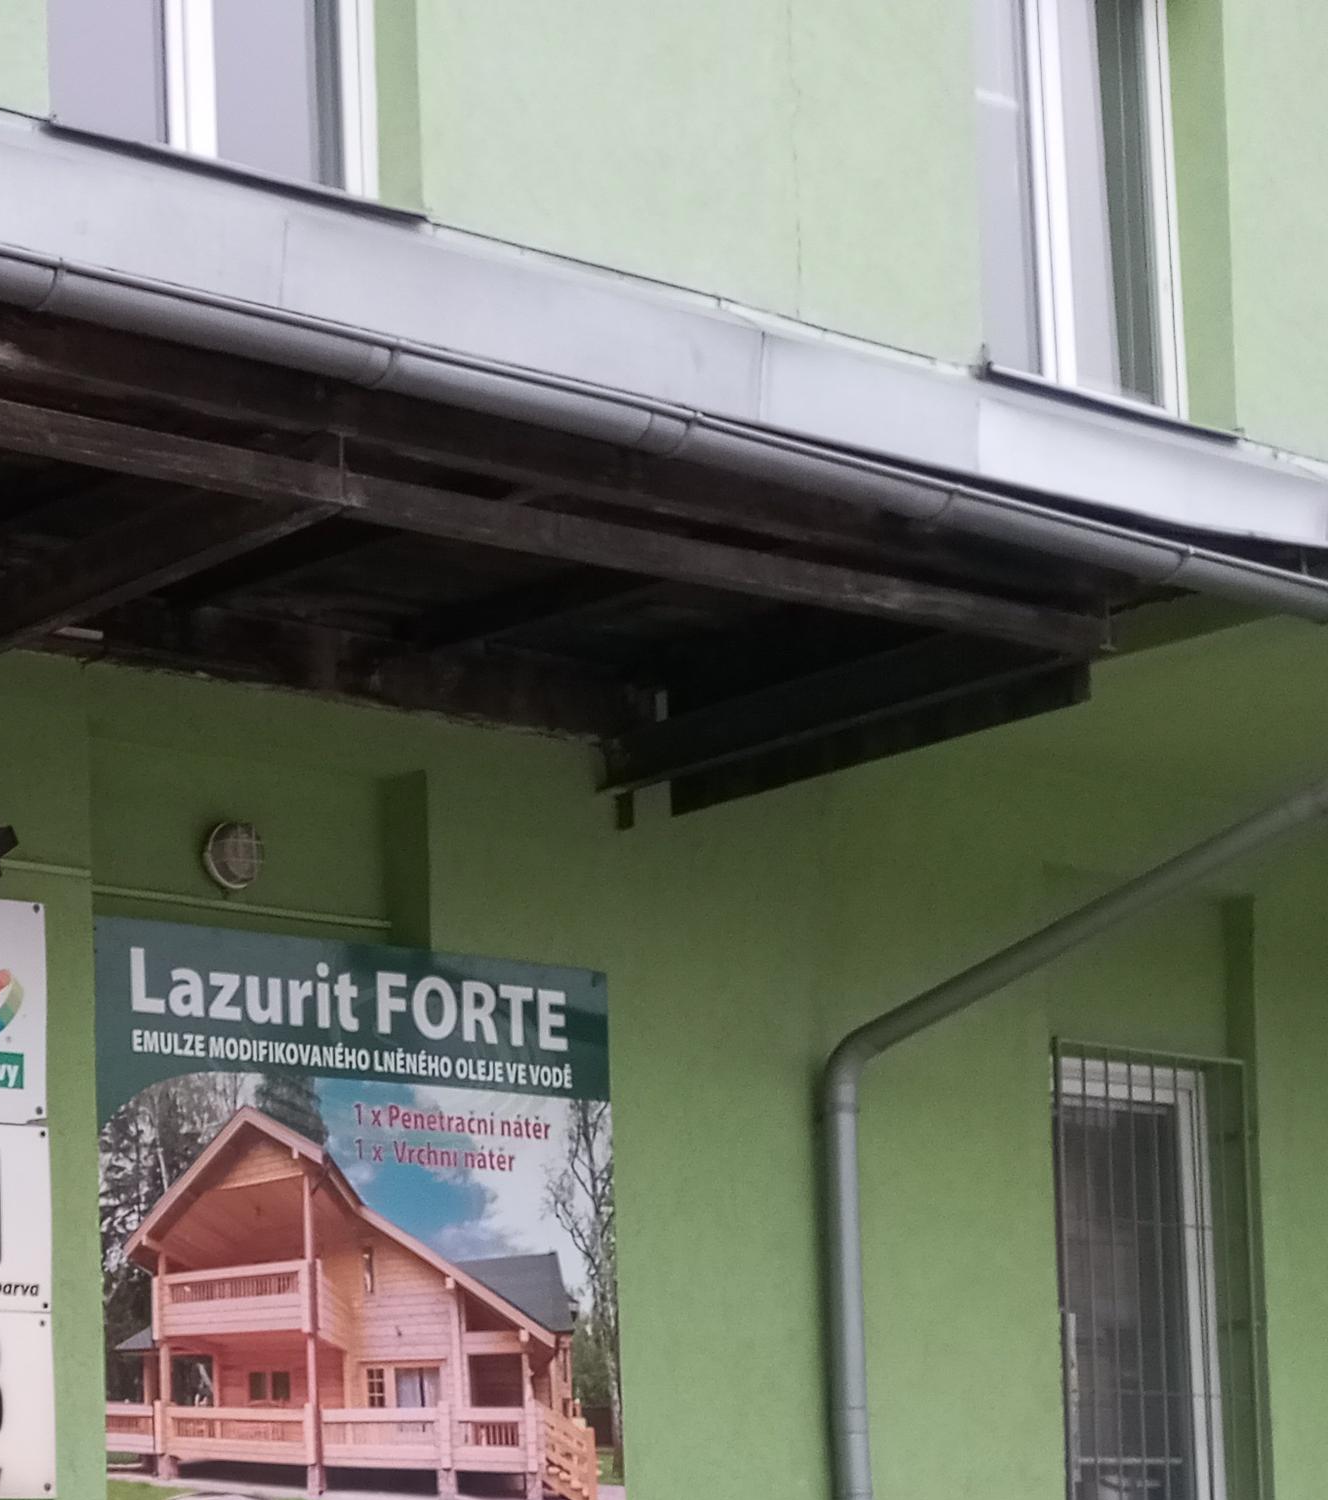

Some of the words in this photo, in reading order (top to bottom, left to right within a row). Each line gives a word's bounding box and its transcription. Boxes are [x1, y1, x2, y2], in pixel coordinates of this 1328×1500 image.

[130, 946, 359, 1032] Lazurit
[375, 970, 569, 1052] FORTE
[132, 1029, 206, 1058] EMULZE
[209, 1037, 370, 1073] MODIFIKOVANÉHO
[373, 1048, 451, 1079] LNĚNÉHO
[455, 1057, 504, 1083] OLEJE
[505, 1061, 528, 1085] VE
[529, 1062, 573, 1089] VODĚ
[353, 1103, 363, 1127] 1
[371, 1110, 382, 1128] x
[354, 1138, 363, 1161] 1
[372, 1145, 383, 1163] x
